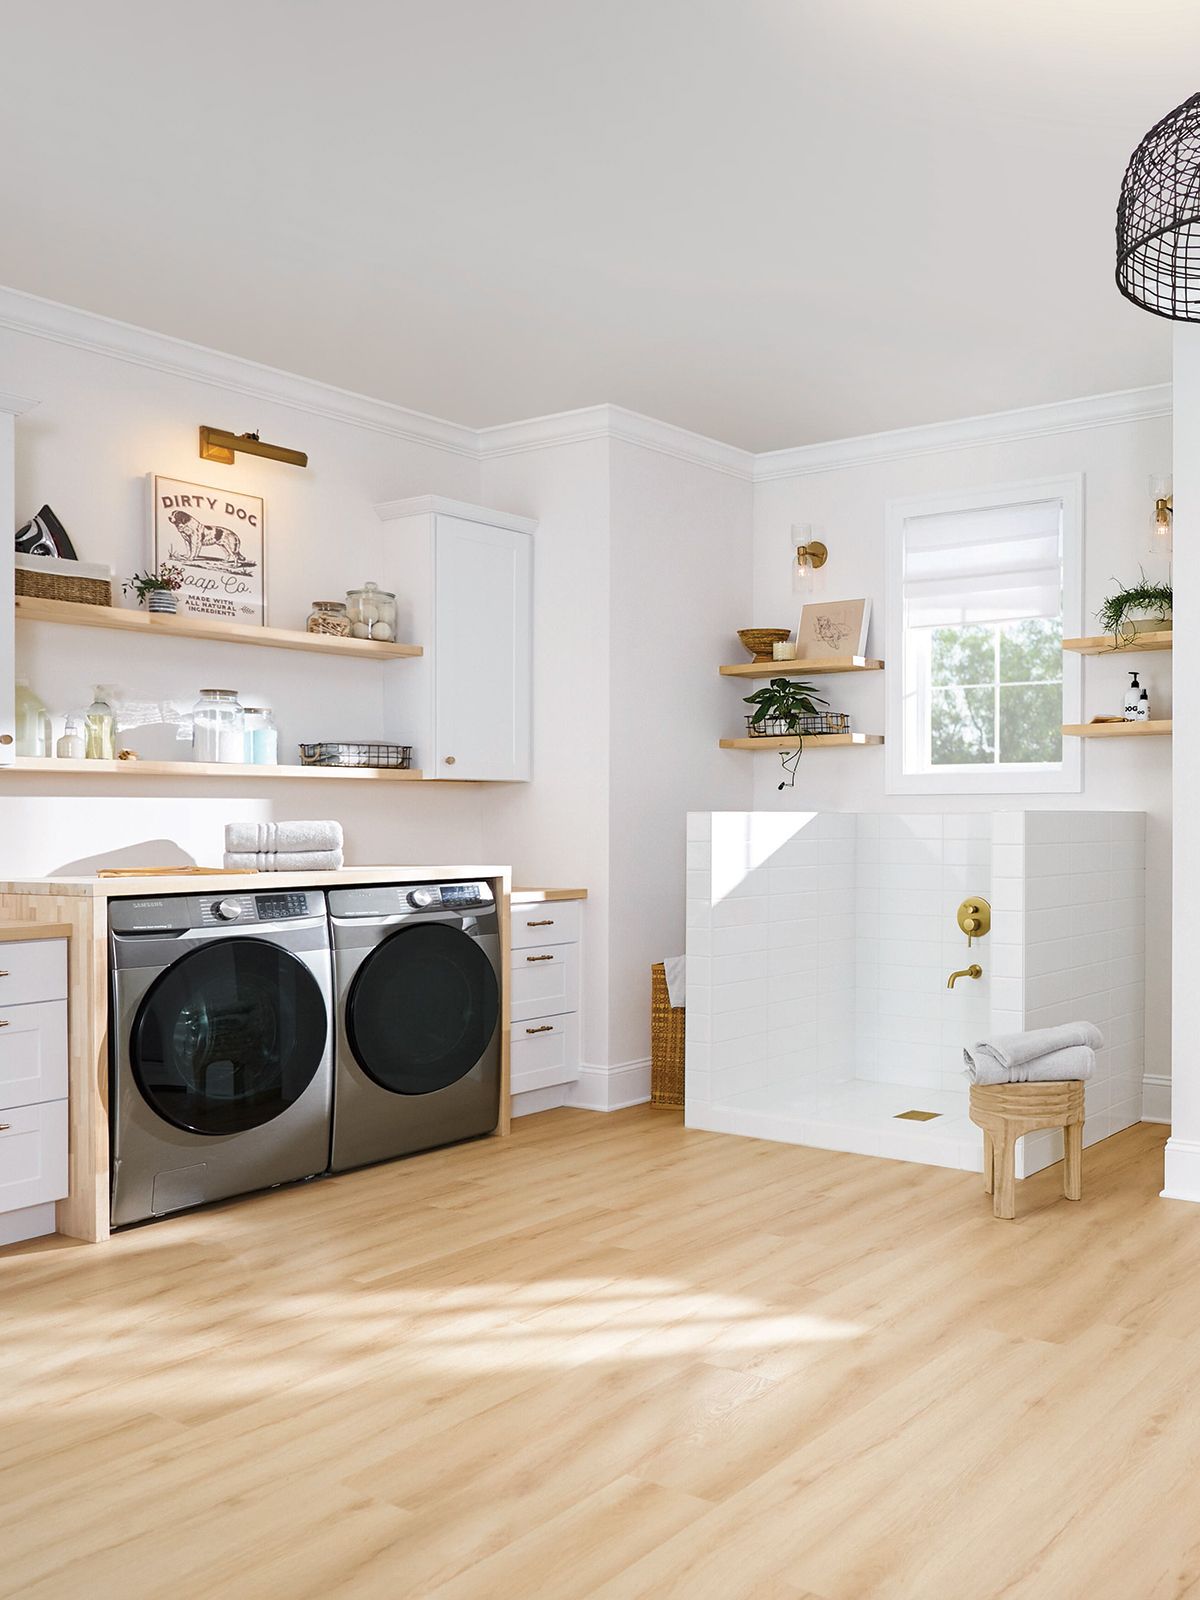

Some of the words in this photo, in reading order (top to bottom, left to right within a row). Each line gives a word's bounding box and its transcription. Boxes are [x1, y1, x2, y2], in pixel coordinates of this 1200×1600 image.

[162, 495, 217, 509] DIRTY
[225, 503, 257, 527] DOG
[221, 576, 252, 594] Co.
[188, 606, 236, 616] INGREDIENTS
[202, 601, 237, 611] NATURAL
